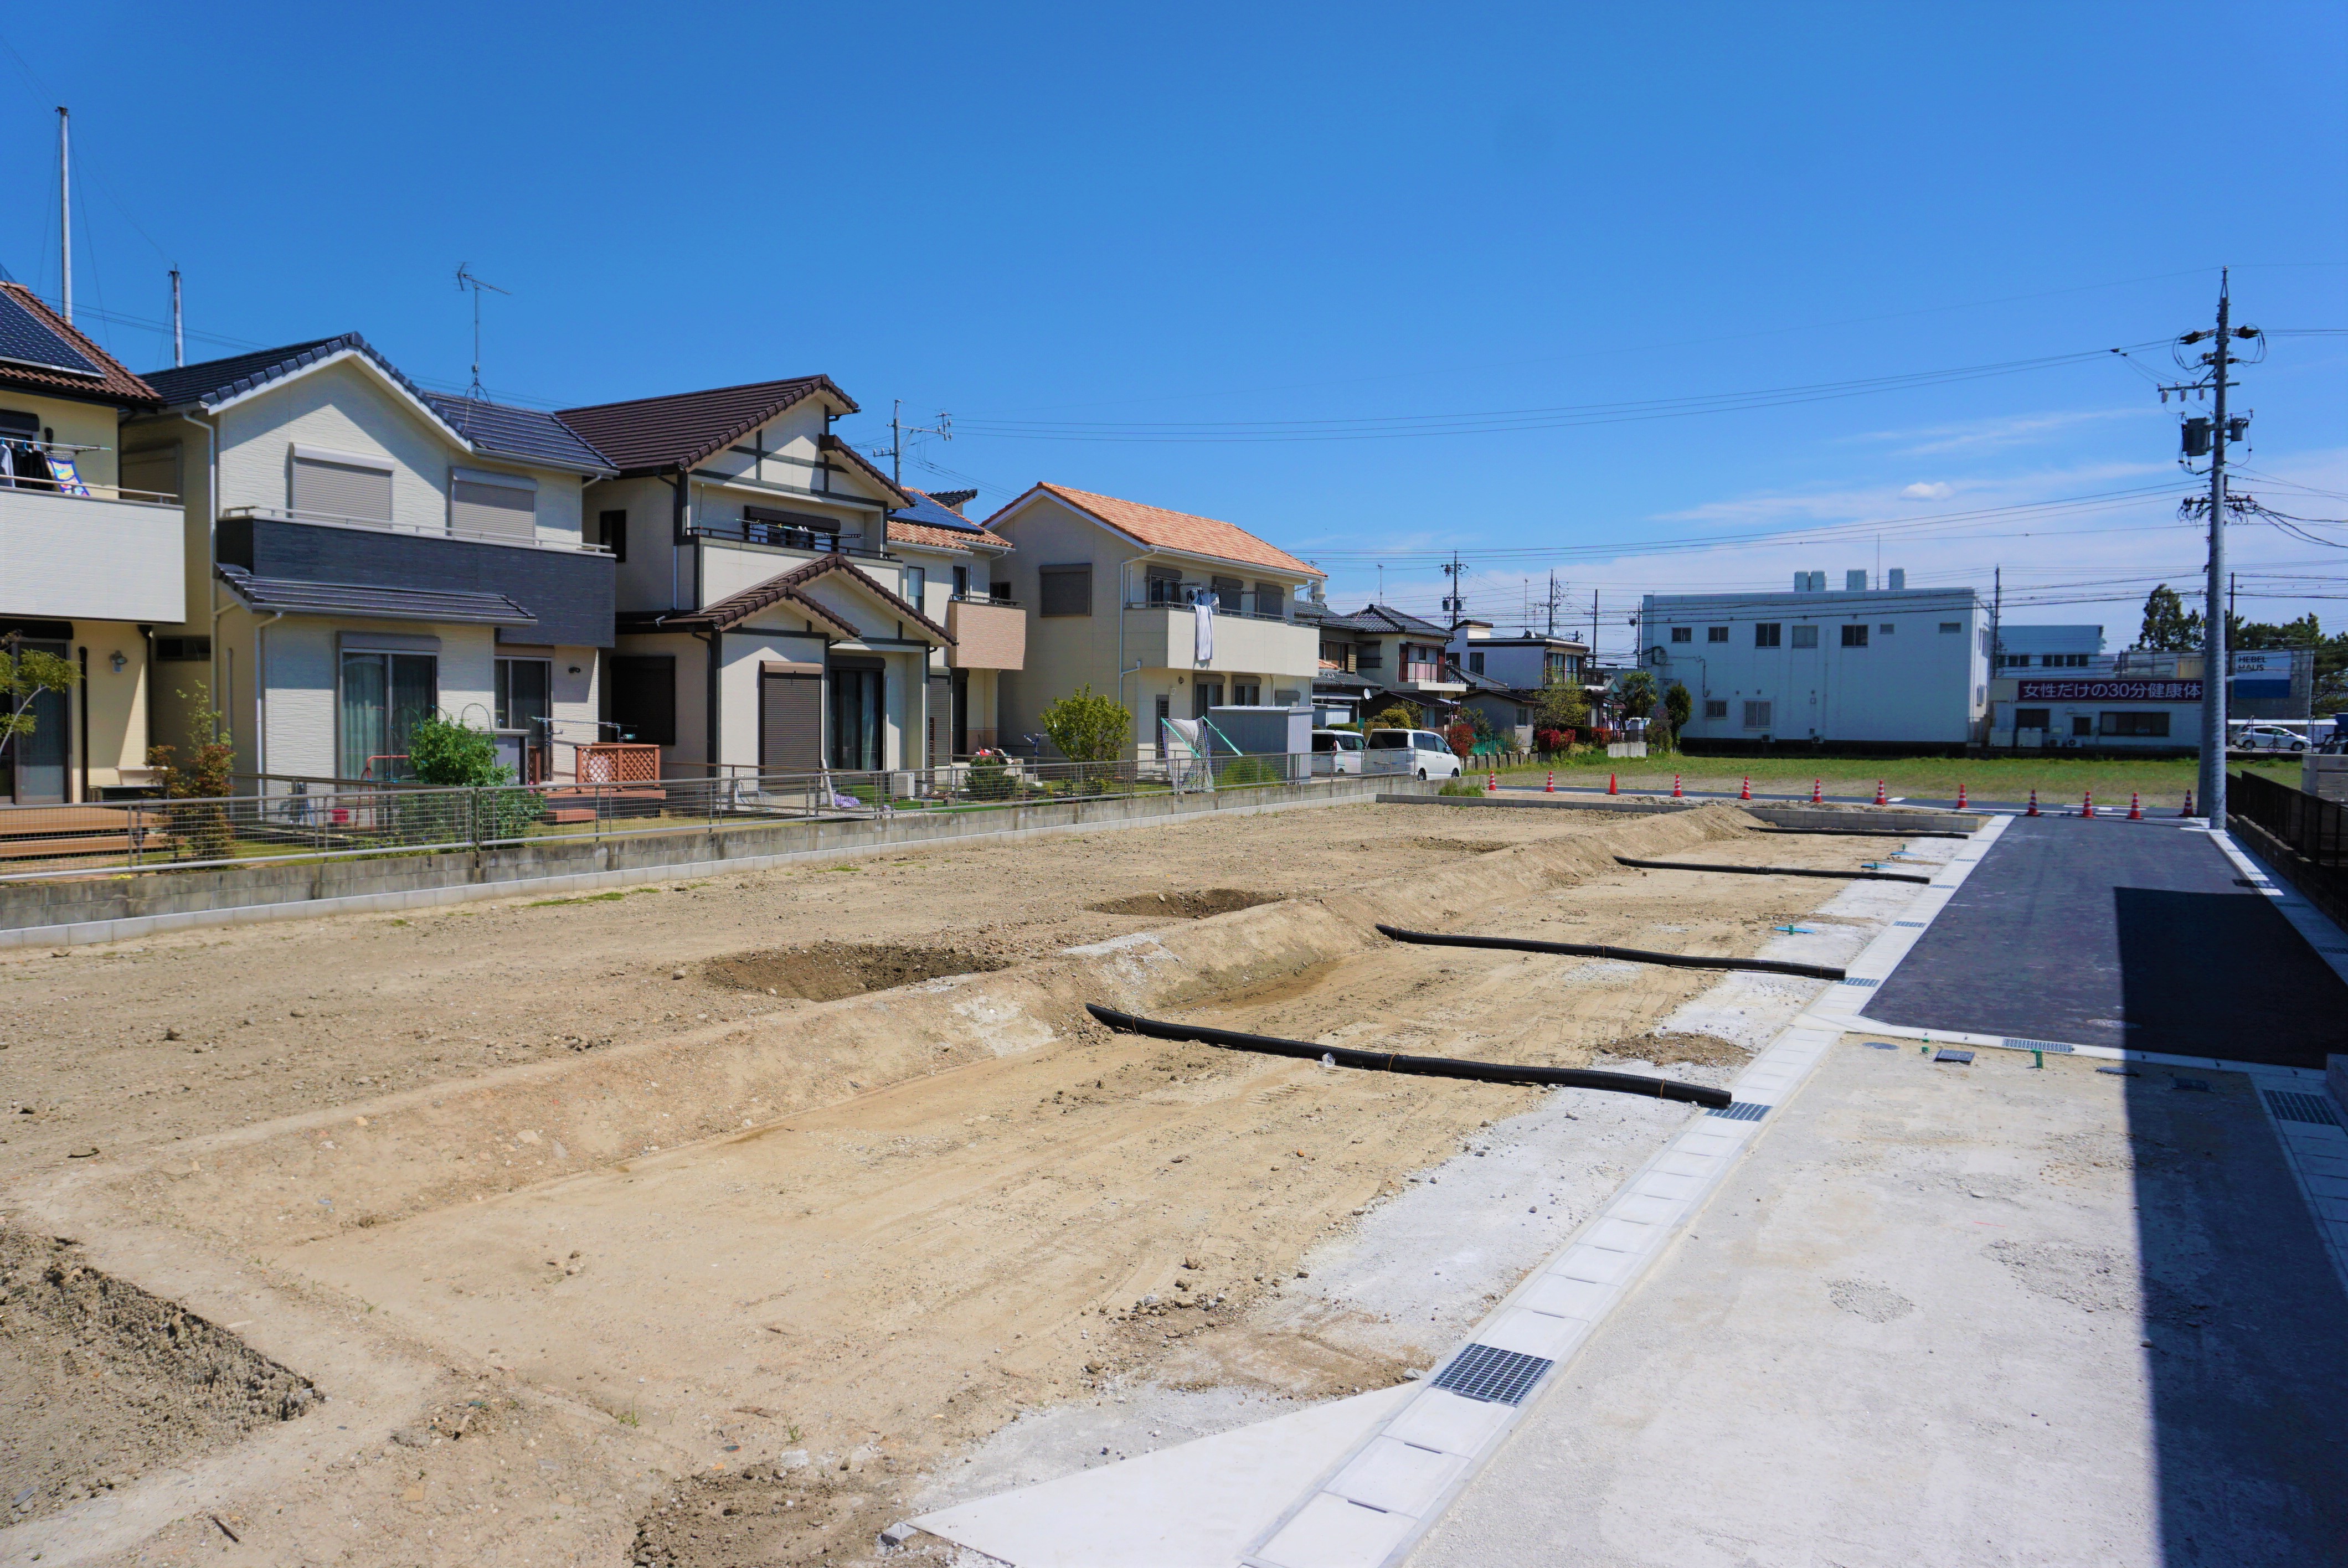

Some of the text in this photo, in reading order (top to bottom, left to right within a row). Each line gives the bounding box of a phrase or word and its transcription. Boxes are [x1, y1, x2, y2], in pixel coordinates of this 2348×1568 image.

[2023, 683, 2201, 698] 女性だけの30分健康体
